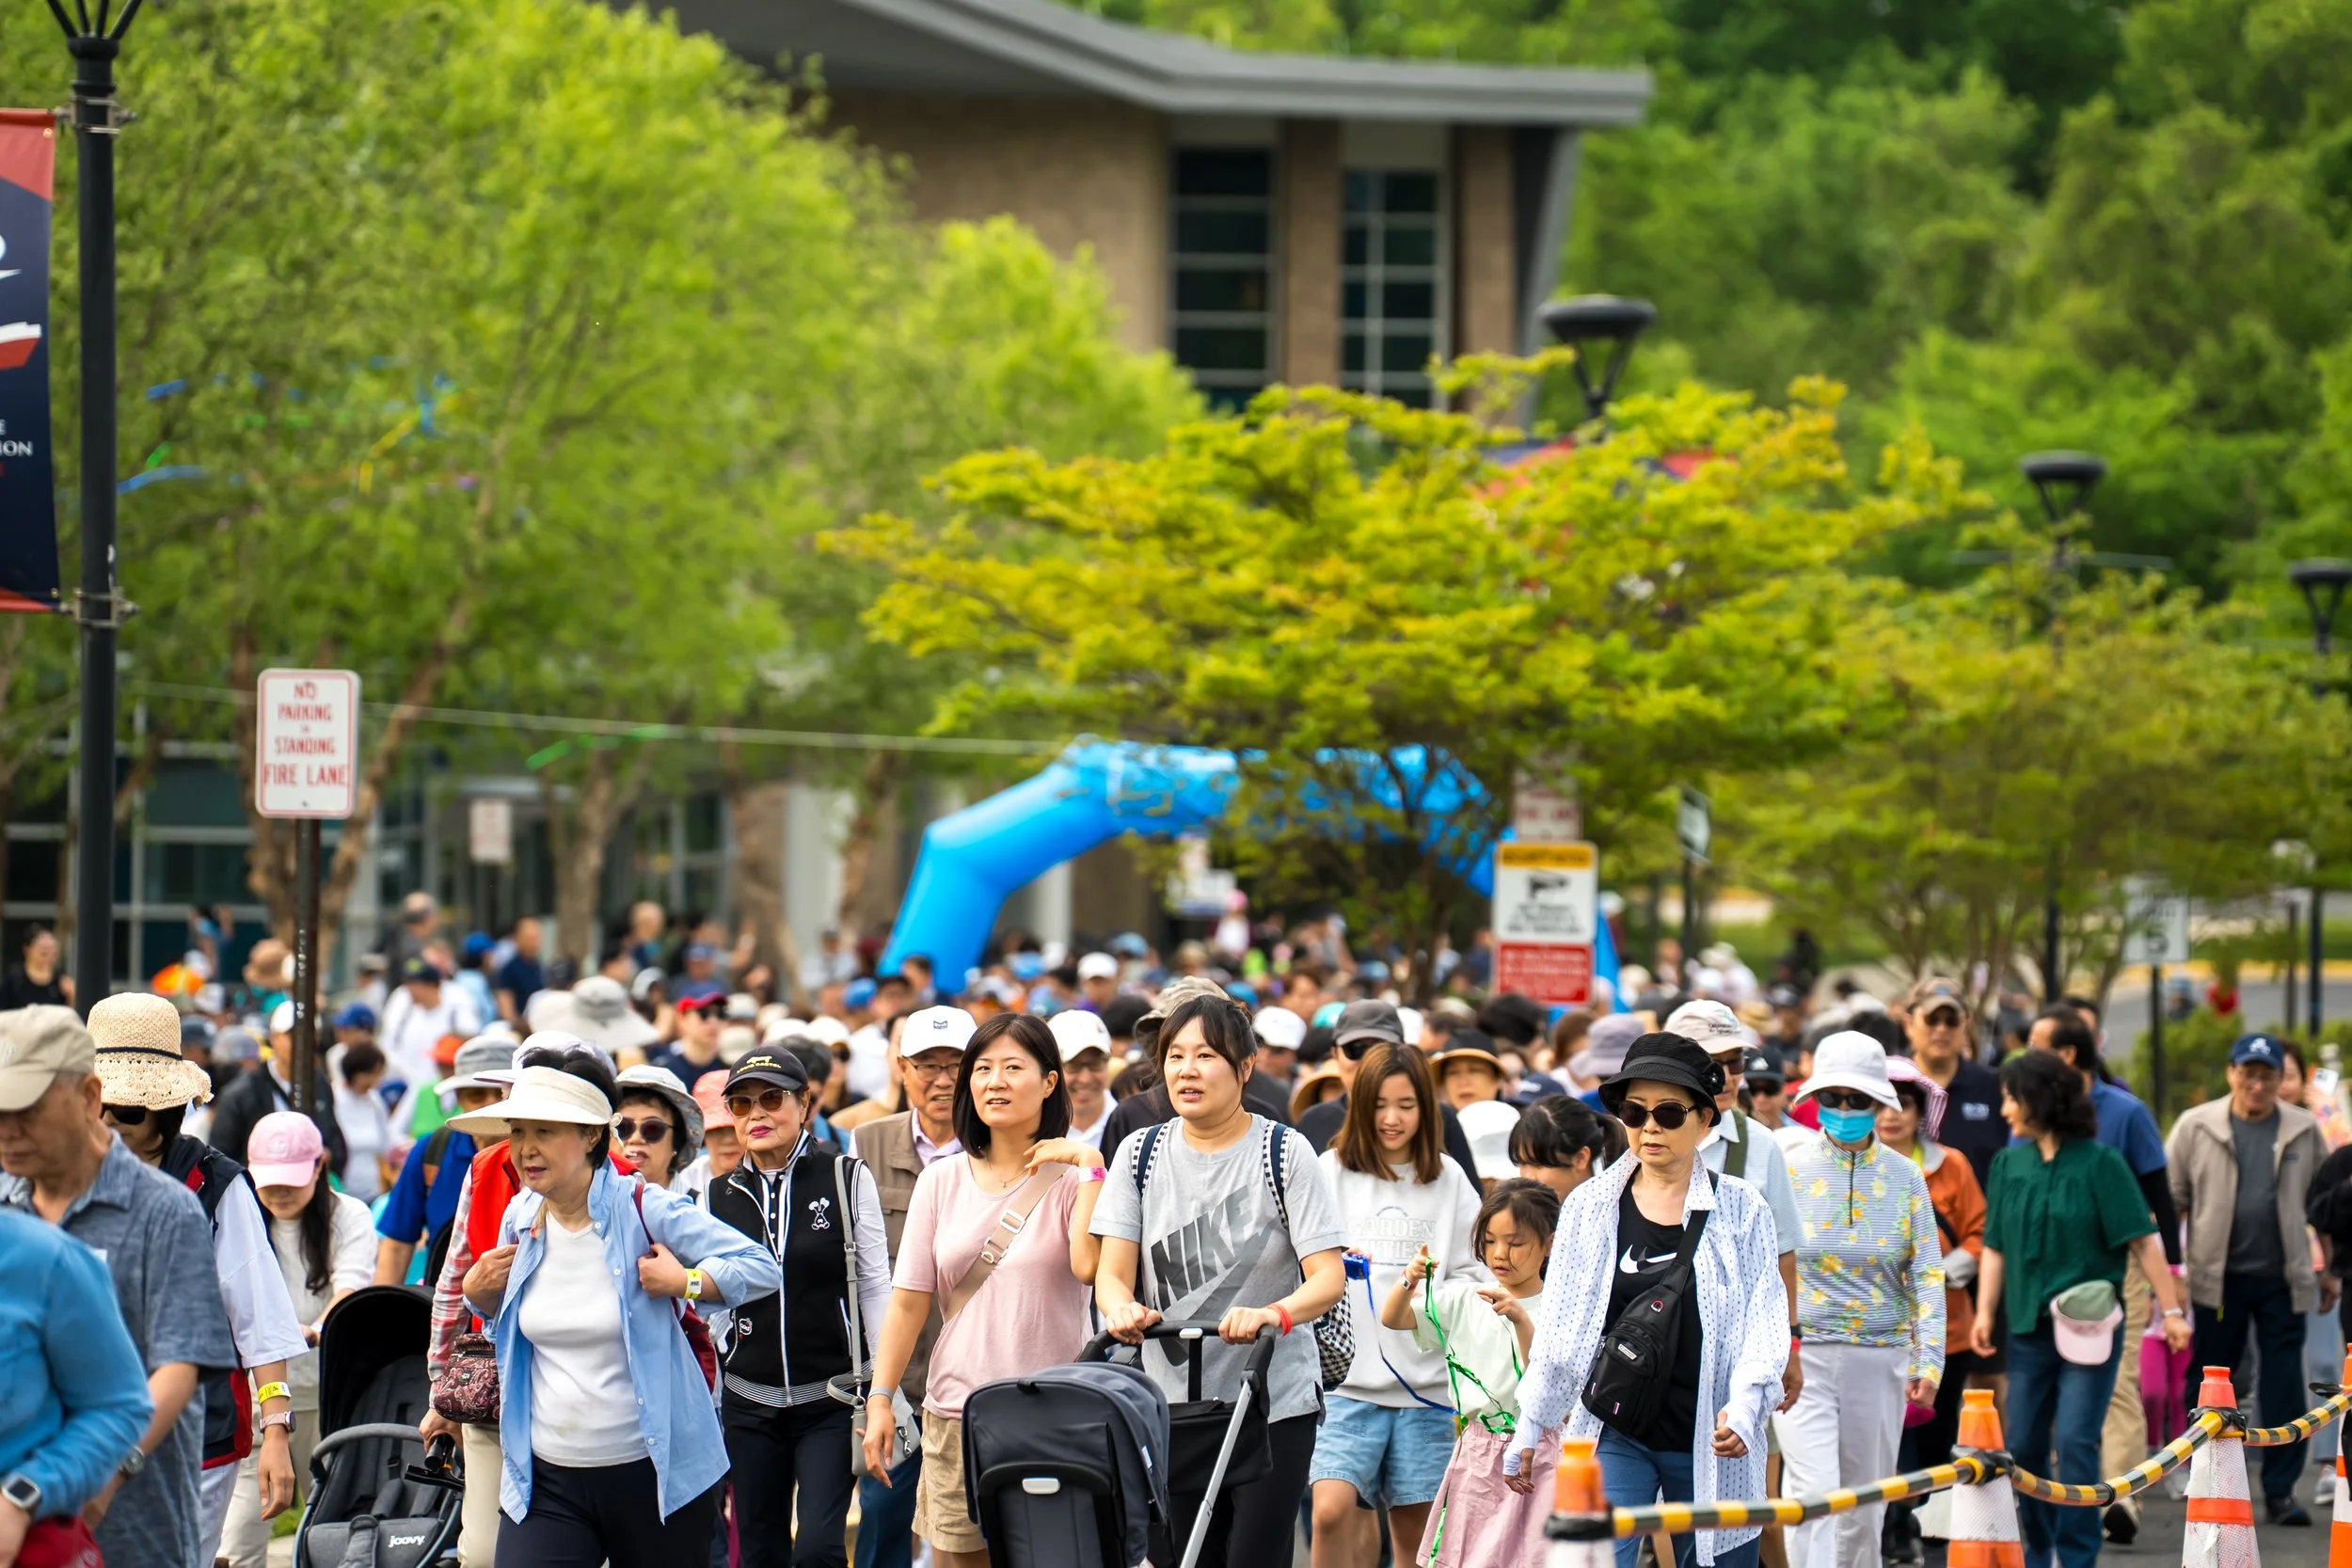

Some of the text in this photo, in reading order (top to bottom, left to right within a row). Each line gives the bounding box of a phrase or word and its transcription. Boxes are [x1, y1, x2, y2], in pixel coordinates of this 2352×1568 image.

[294, 682, 317, 699] NO
[278, 704, 332, 721] PARKING
[275, 736, 336, 756] STANDING
[263, 763, 347, 786] FIRE LANE
[1347, 1216, 1436, 1239] GARDEN
[1151, 1184, 1260, 1312] NIKE
[388, 1535, 425, 1548] joovy
